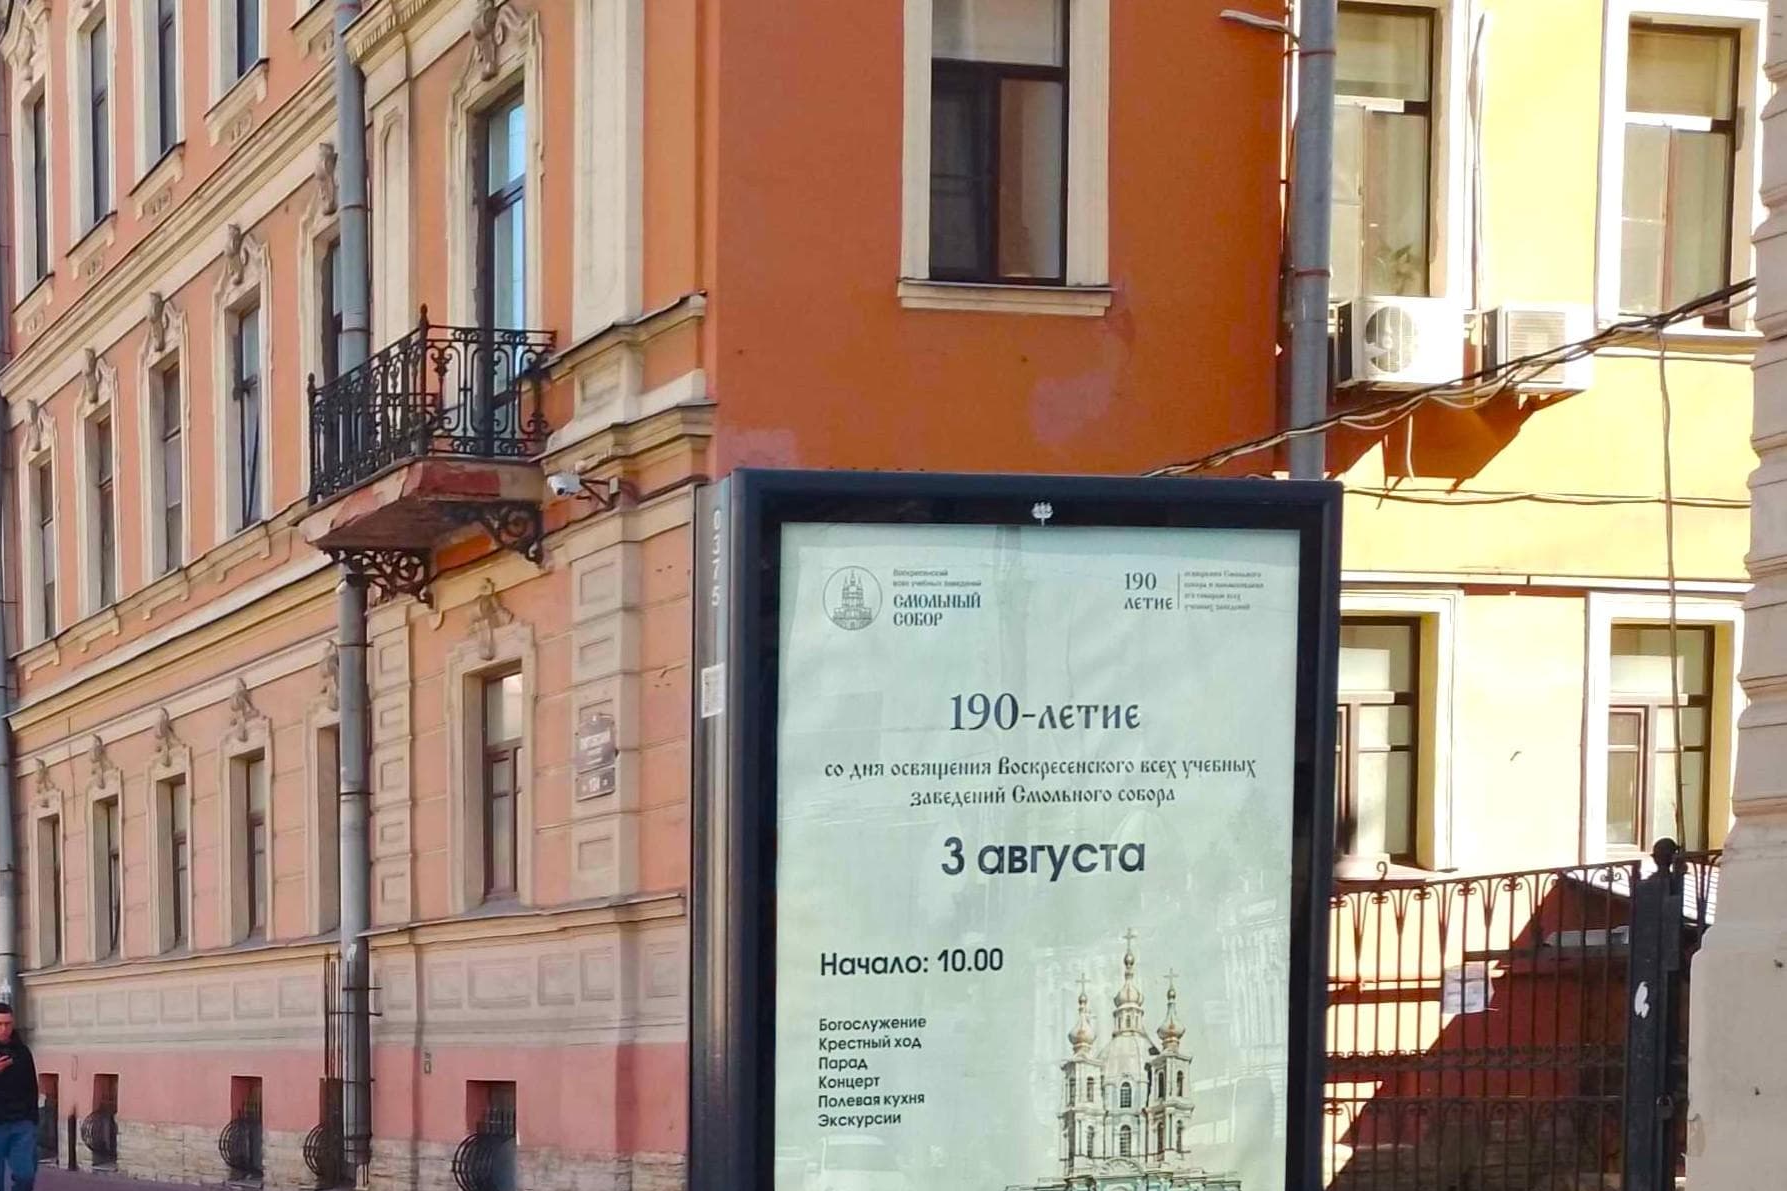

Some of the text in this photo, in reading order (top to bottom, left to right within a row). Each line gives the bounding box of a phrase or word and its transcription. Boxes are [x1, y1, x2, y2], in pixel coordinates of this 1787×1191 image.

[1125, 571, 1157, 590] 190
[893, 592, 981, 609] СМОЛЬНЫЙ
[893, 611, 943, 627] СОБОР
[949, 693, 1140, 731] 190-летие
[825, 756, 1256, 781] со дня освящения Воскресенского всех учебных
[909, 784, 1175, 808] заведений Смольного собора
[941, 836, 1145, 882] 3 августа
[820, 947, 1004, 977] Начало: 10.00
[819, 1016, 927, 1032] Богослужение
[819, 1035, 922, 1053] Крестный ход
[818, 1056, 868, 1072] Парад
[818, 1075, 880, 1091] Концерт
[818, 1093, 925, 1109] Полевая кухня
[818, 1112, 901, 1128] Экскурсии
